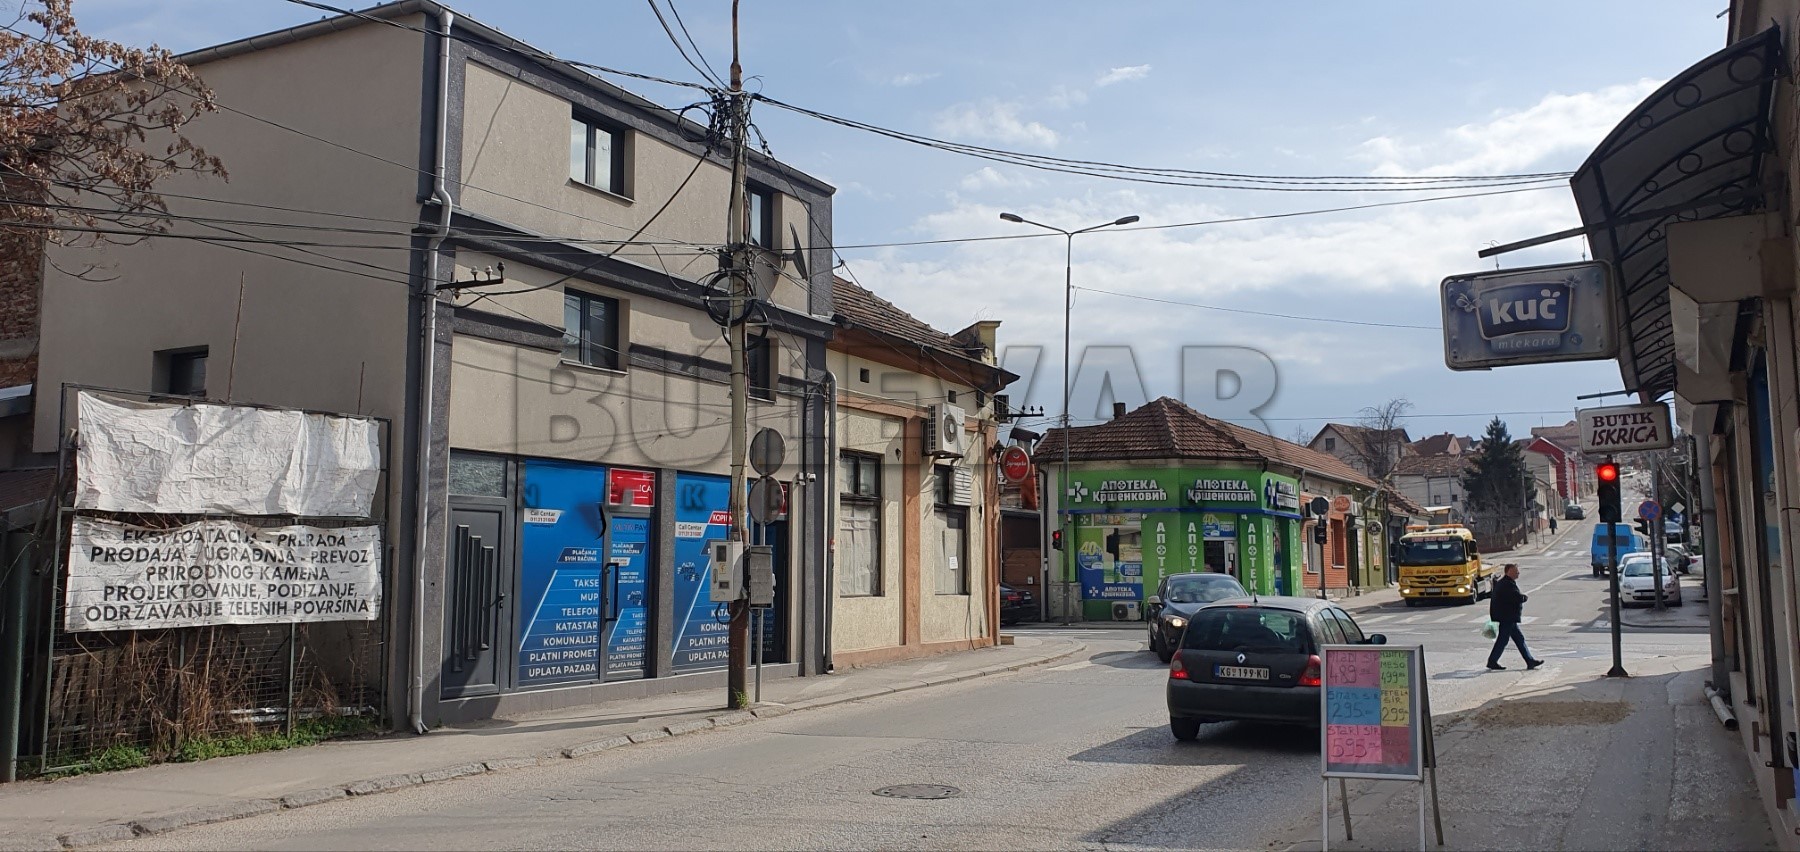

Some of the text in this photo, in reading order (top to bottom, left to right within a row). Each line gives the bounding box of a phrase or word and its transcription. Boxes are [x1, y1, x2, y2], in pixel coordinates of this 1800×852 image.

[1490, 289, 1561, 325] kuč
[1592, 412, 1654, 428] BUTIK
[1591, 426, 1659, 446] ISKRICA
[90, 546, 184, 563] PRODAJA
[204, 547, 296, 563] UGRADNJA
[311, 549, 368, 564] PREVOZ
[145, 565, 330, 581] PRIRODNOG KAMENA
[574, 579, 599, 587] TAKSE
[581, 593, 599, 601] MUP
[85, 597, 369, 622] ODRŽAVANJE ZELENIH POVRŠINA
[562, 607, 599, 616] TELEFON
[556, 621, 598, 631] KATASTAR
[543, 635, 597, 646] KOMUNALIJE
[689, 637, 716, 647] PLATNI
[530, 649, 597, 662] PLATNI PROMET
[688, 651, 717, 661] UPLATA
[528, 663, 596, 677] UPLATA PAZARA
[1220, 667, 1231, 677] KG
[1331, 737, 1367, 758] 595
